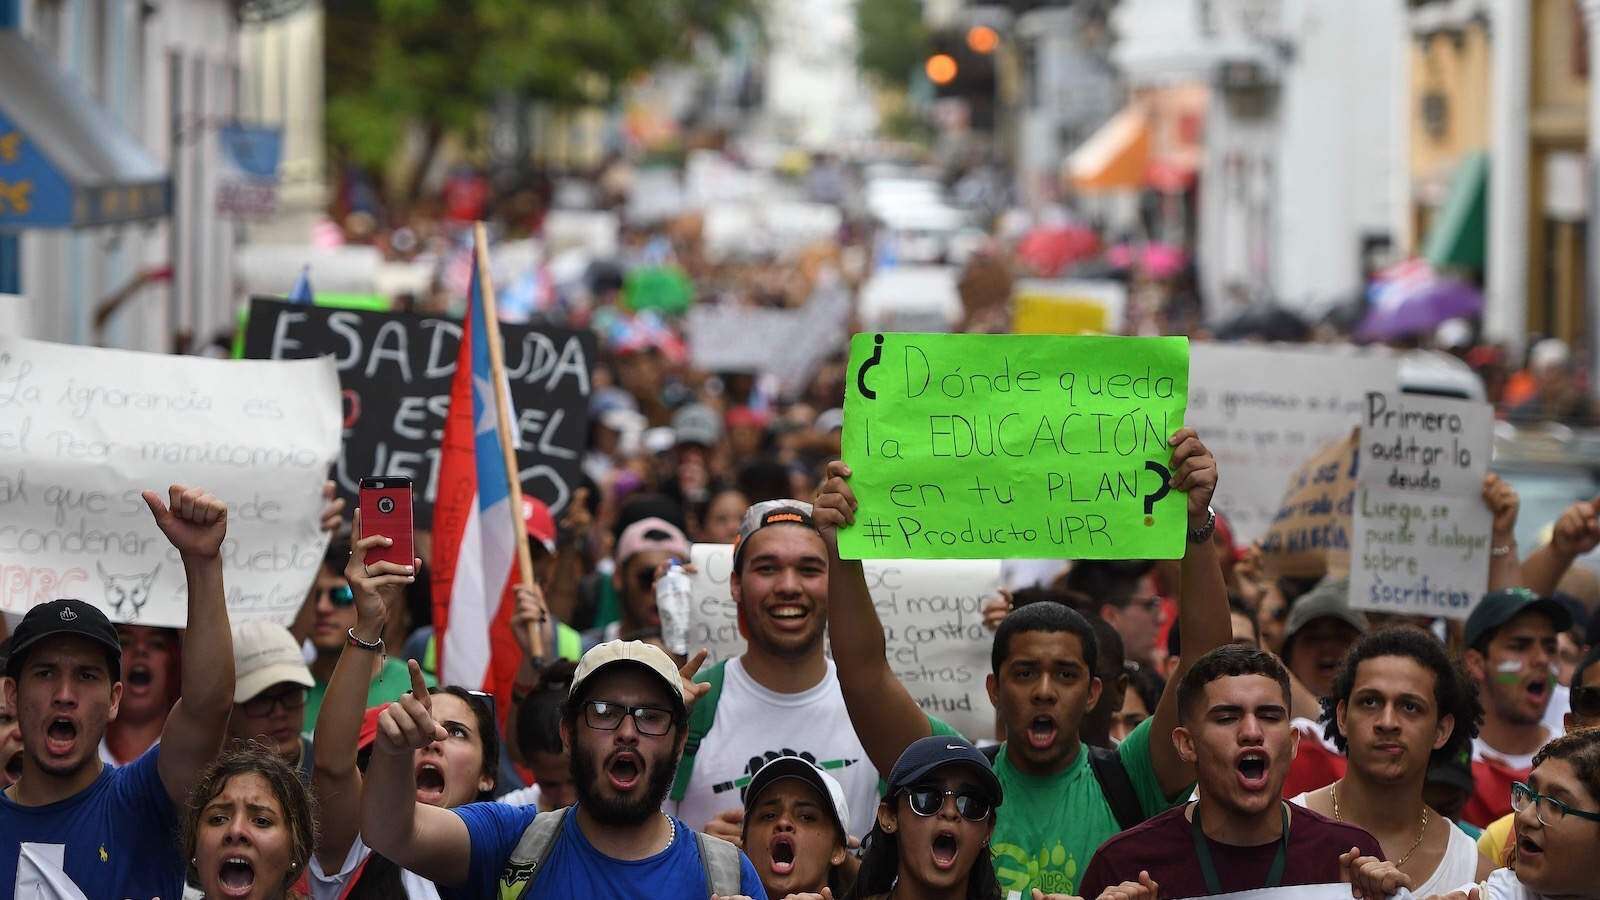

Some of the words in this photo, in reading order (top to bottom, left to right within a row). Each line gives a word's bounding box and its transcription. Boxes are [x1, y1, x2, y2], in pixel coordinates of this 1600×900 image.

[420, 318, 591, 397] DUDA
[56, 376, 213, 420] ignorancia
[1059, 365, 1175, 407] queda
[865, 417, 904, 460] la
[929, 407, 1169, 458] EDUCACIÓN
[43, 484, 109, 528] que
[889, 482, 946, 508] en
[967, 475, 1015, 505] tu
[0, 515, 160, 556] condenar
